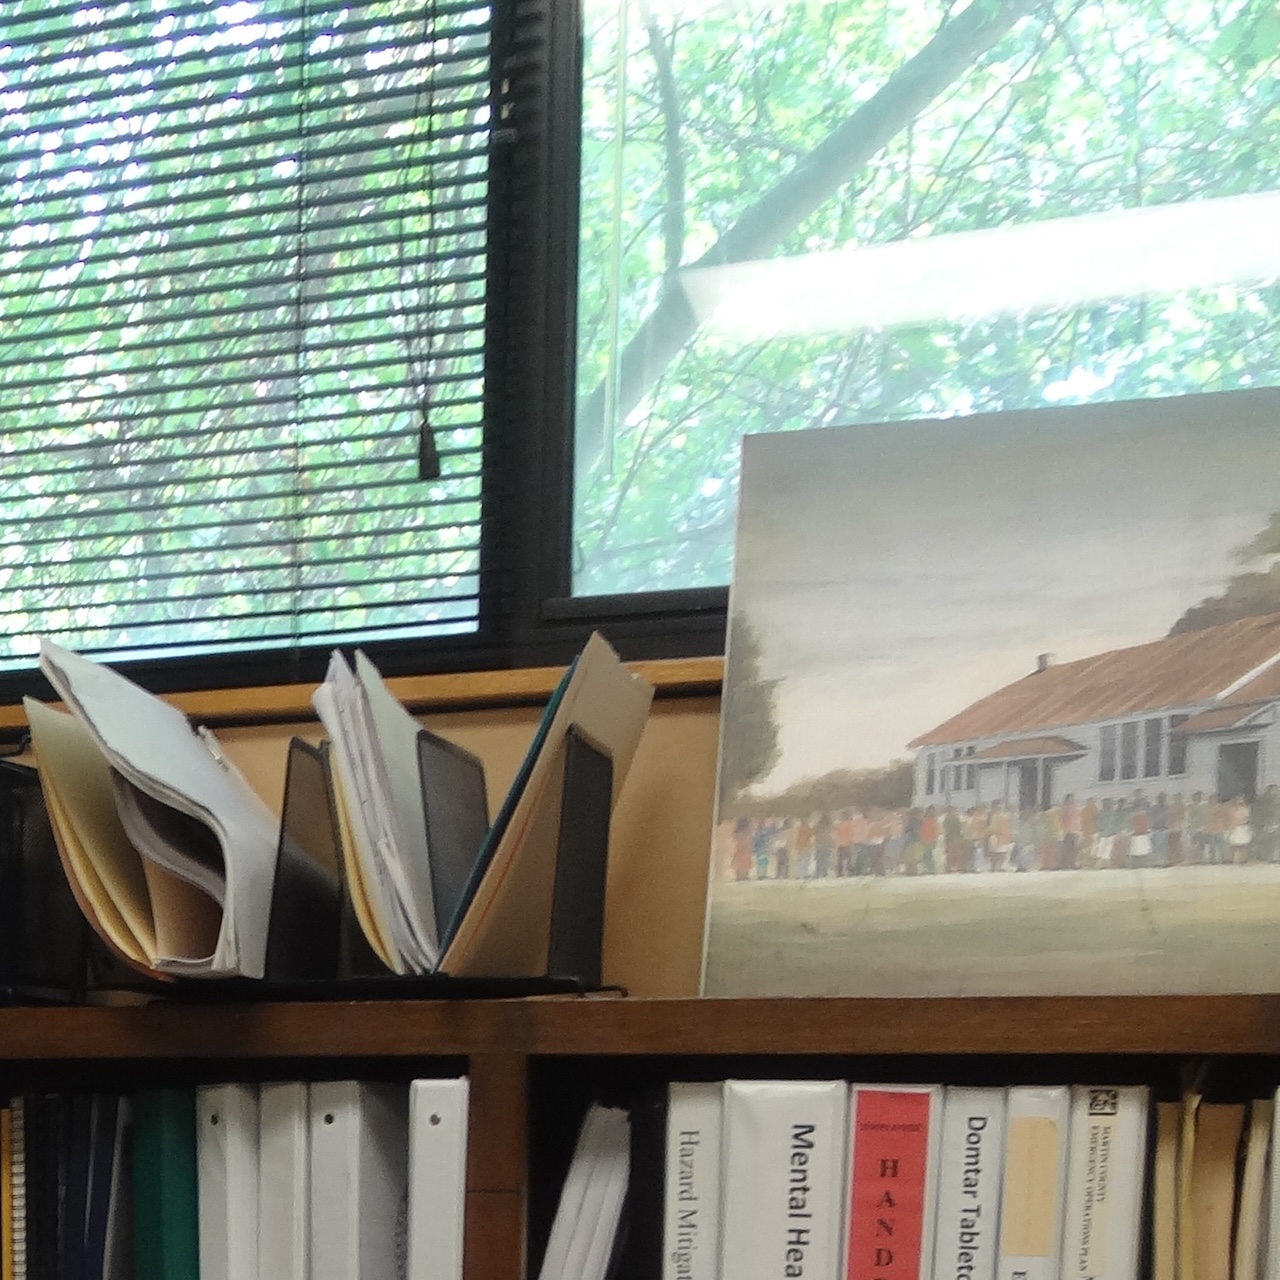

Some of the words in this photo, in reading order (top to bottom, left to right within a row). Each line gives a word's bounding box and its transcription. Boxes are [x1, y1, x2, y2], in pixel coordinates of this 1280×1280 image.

[678, 1130, 700, 1202] Hazard
[787, 1123, 816, 1218] Mental
[962, 1116, 988, 1198] Domtar
